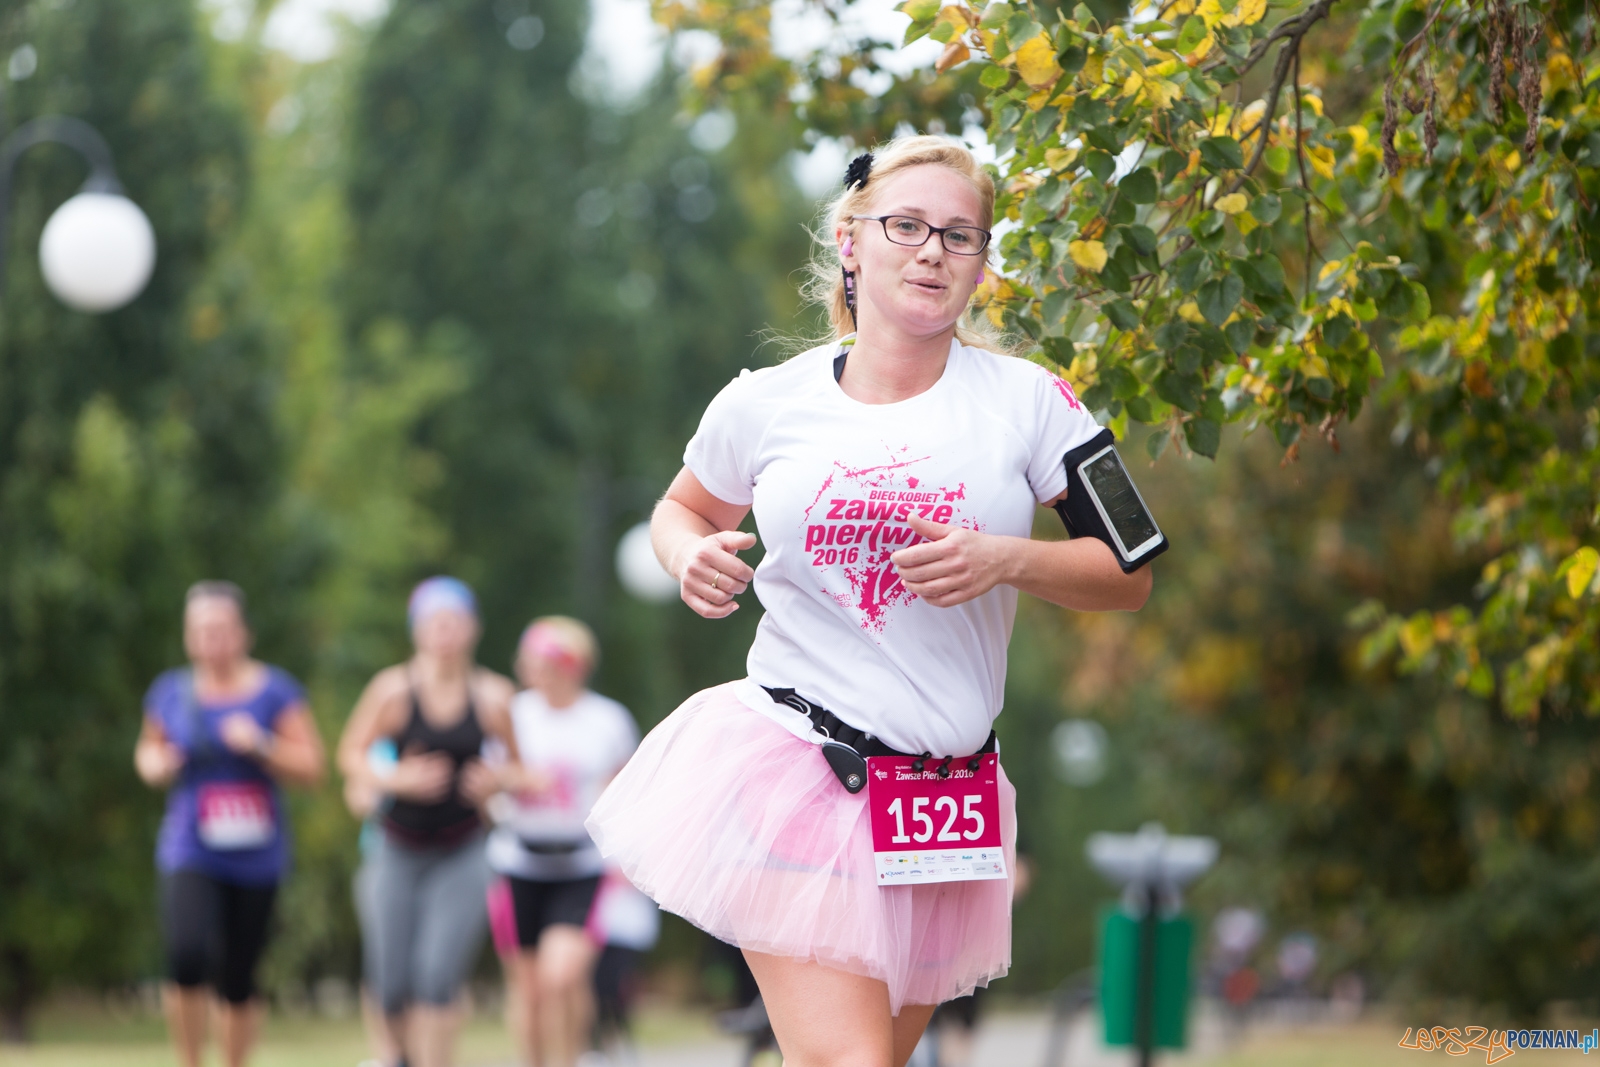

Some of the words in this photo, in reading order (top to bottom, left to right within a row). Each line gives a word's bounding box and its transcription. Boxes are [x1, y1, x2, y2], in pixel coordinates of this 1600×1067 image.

[869, 490, 895, 501] BIEG
[898, 491, 940, 503] KOBIET
[826, 499, 953, 524] zawsze
[812, 547, 859, 566] 2016
[895, 770, 921, 781] Zawsze
[954, 769, 974, 779] 2016
[887, 795, 985, 844] 1525
